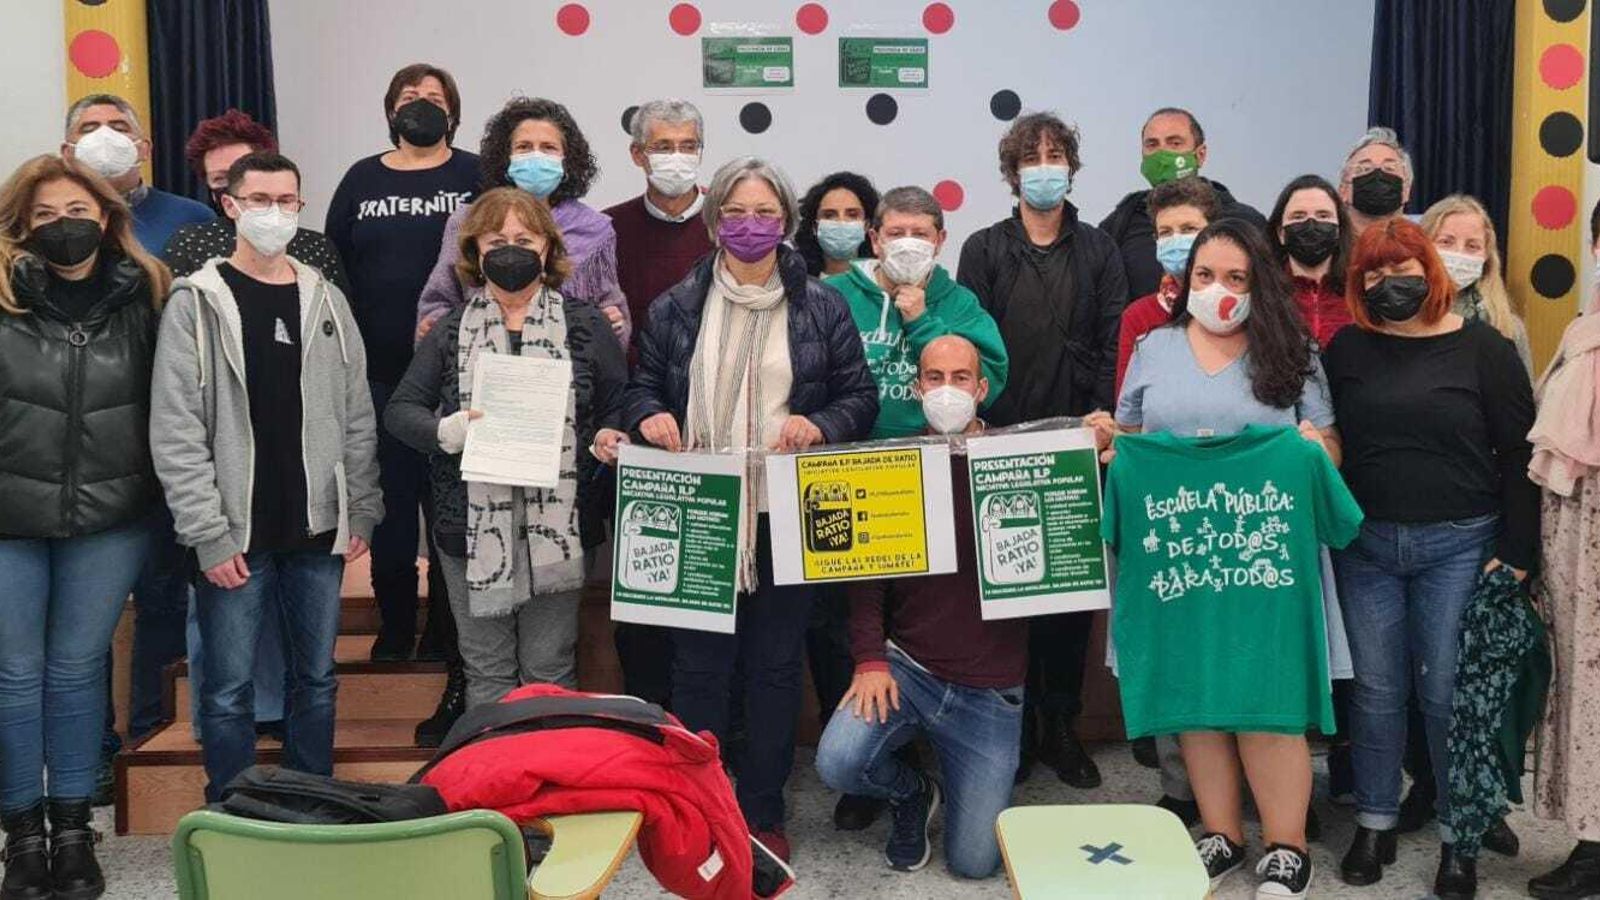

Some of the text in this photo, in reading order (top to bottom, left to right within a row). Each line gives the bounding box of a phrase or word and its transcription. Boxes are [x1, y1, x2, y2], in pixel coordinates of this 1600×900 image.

[883, 455, 893, 464] DE
[894, 454, 918, 463] RATIO
[974, 453, 1055, 473] PRESENTACIÓN
[622, 467, 701, 486] PRESENTACIÓN
[975, 470, 1031, 485] CAMPAÑA
[622, 479, 676, 495] CAMPAÑA
[1146, 488, 1294, 520] ESCUELA PÚBLICA:
[816, 511, 850, 528] BAJADA
[815, 521, 850, 540] RATIO
[996, 528, 1038, 551] BAJADA
[633, 541, 675, 558] BAJADA
[829, 533, 849, 548] ¡YA!
[1166, 531, 1279, 558] DE TOD@S
[633, 553, 675, 571] RATIO
[997, 541, 1040, 566] RATIO
[1157, 567, 1295, 599] PARA TOD@S
